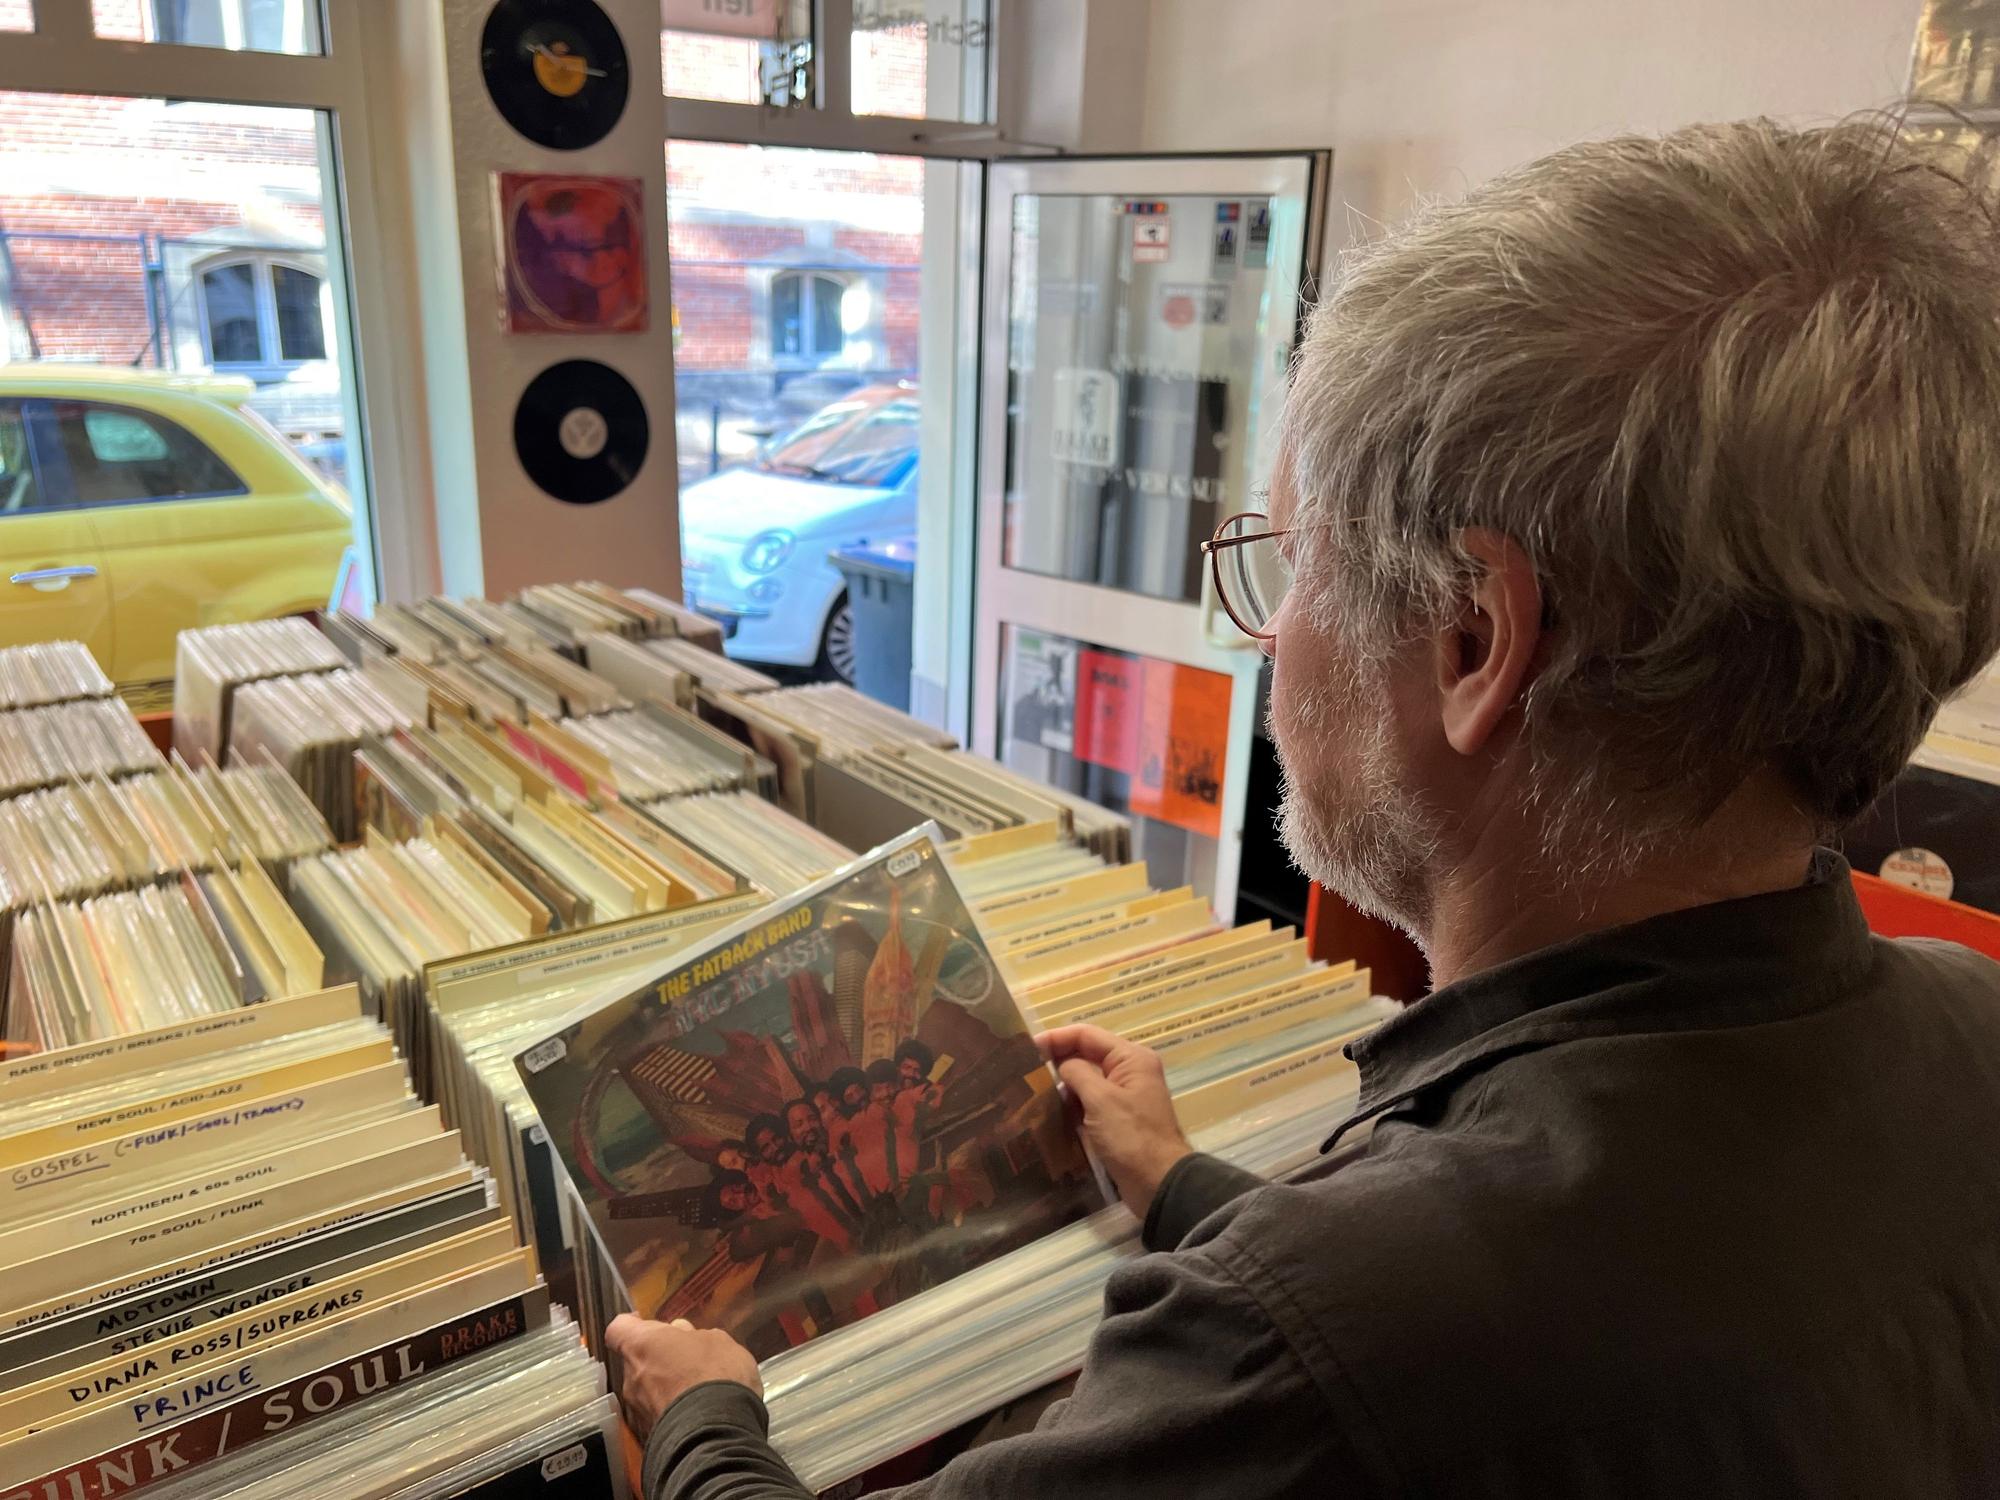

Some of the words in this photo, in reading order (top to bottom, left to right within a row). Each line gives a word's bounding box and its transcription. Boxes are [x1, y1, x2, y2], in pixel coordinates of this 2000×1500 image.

[657, 972, 691, 1004] THE
[692, 931, 766, 986] FATBACK
[767, 906, 813, 946] BAND
[9, 1062, 48, 1077] RARE
[53, 1047, 114, 1067] GROOVE
[127, 1031, 185, 1049] BREAKS
[76, 1117, 111, 1132] NEW
[116, 1104, 159, 1120] SOUL
[12, 1153, 99, 1185] GOSPEL
[91, 1193, 184, 1226] NORTHERN
[205, 1179, 230, 1191] 60s
[234, 1165, 278, 1183] SOUL
[129, 1231, 156, 1246] 70s
[161, 1217, 207, 1236] SOUL
[220, 1199, 264, 1217] FUNK
[97, 1279, 216, 1335] MOTOWN
[112, 1316, 195, 1356] STEVIE
[210, 1275, 314, 1318] WONDER
[441, 1309, 518, 1347] DRAKE
[68, 1360, 159, 1403] DIANA
[134, 1366, 254, 1423] PRINCE
[216, 1411, 232, 1457] /
[263, 1344, 424, 1431] SOUL
